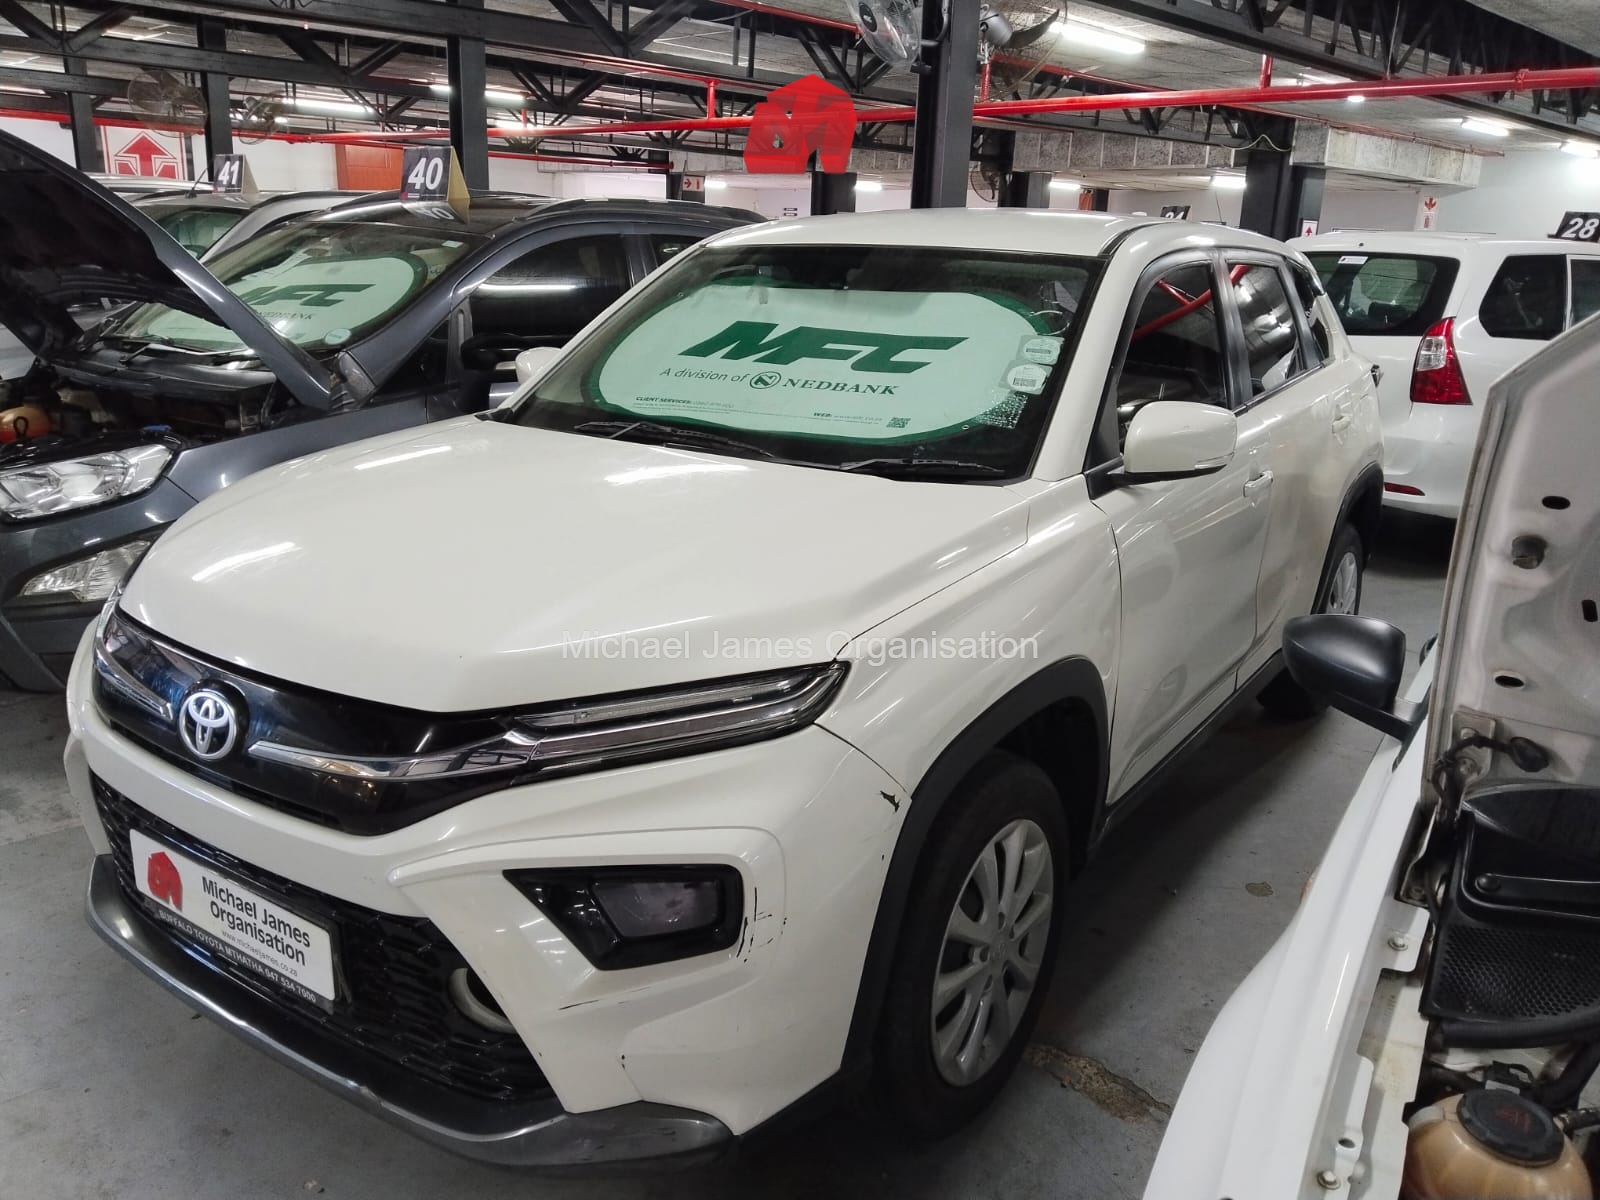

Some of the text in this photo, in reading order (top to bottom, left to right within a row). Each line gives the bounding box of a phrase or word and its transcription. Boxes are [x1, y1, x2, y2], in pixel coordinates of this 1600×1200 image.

[218, 160, 240, 185] 41
[407, 157, 443, 190] 40
[1561, 217, 1599, 239] 28
[678, 320, 970, 374] MFC
[659, 367, 900, 396] A division of NEDBANK
[202, 875, 311, 948] Michael James
[193, 928, 225, 953] TOYOTA
[210, 900, 306, 966] Organisation
